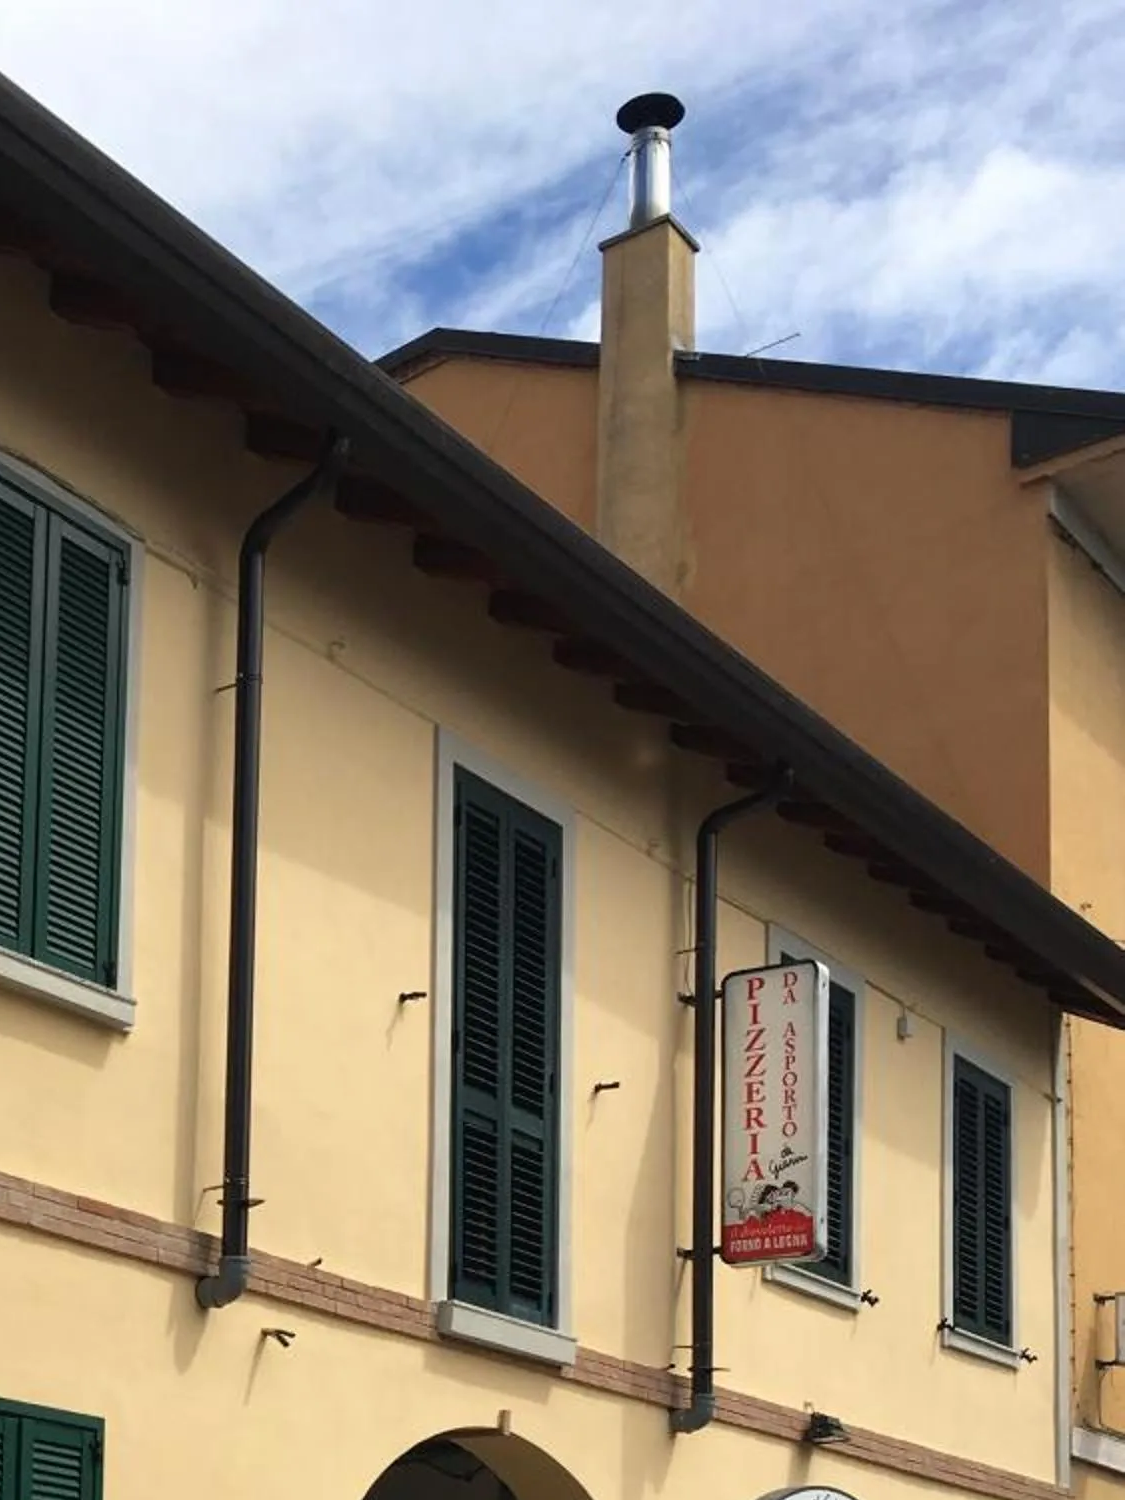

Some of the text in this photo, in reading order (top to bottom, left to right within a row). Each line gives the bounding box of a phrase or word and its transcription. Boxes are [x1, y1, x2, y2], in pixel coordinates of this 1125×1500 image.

[743, 976, 767, 1182] PIZZERIA
[782, 971, 798, 1137] DA ASPORTO
[730, 1233, 809, 1254] FORNO A LEGNA
